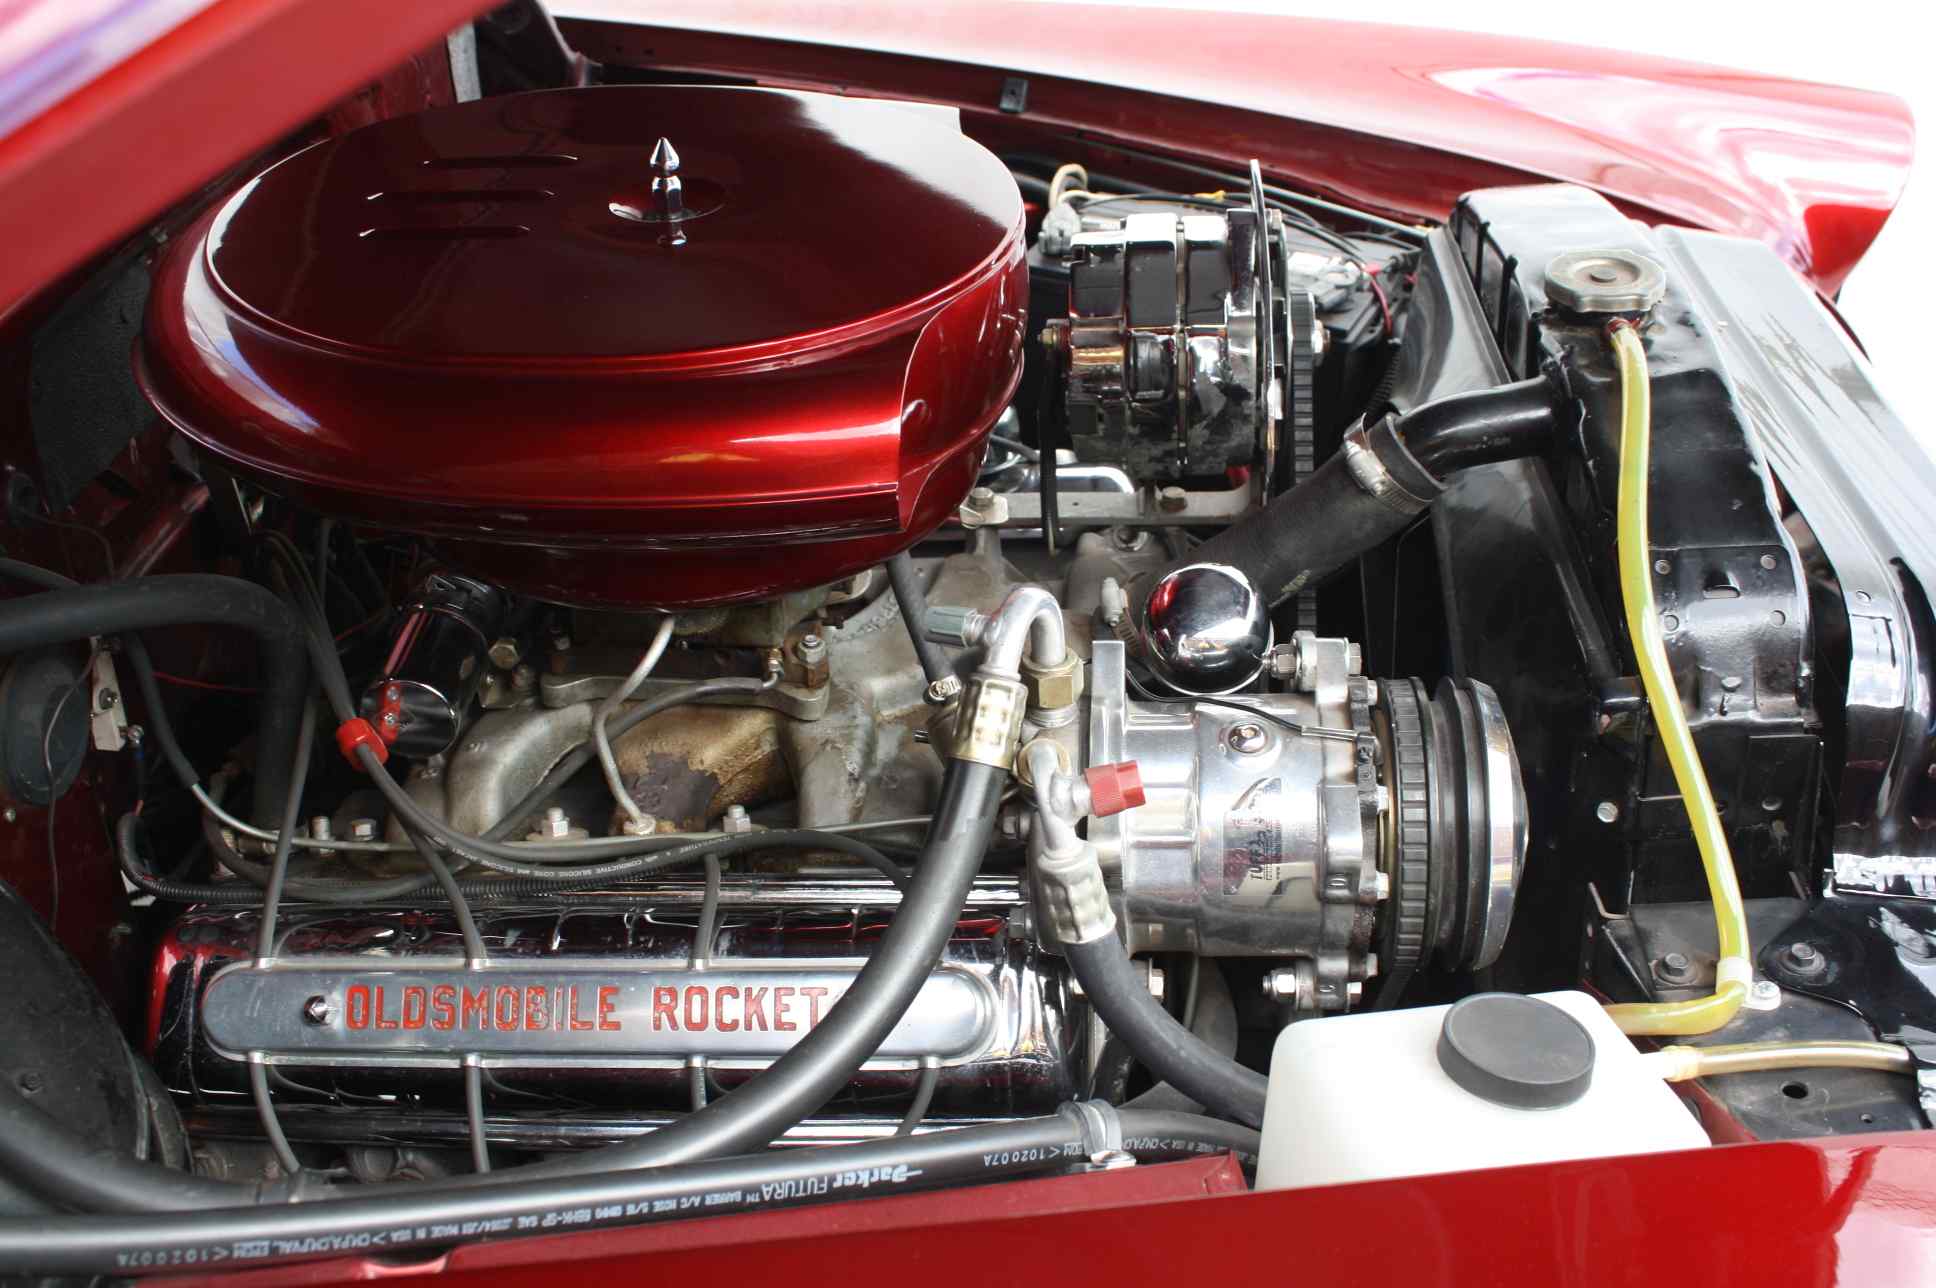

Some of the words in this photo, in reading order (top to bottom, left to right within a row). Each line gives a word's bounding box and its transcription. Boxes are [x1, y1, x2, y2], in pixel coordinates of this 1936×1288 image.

[345, 985, 622, 1031] OLDSMOBILE
[651, 986, 827, 1031] ROCKET
[833, 1164, 911, 1188] Parker
